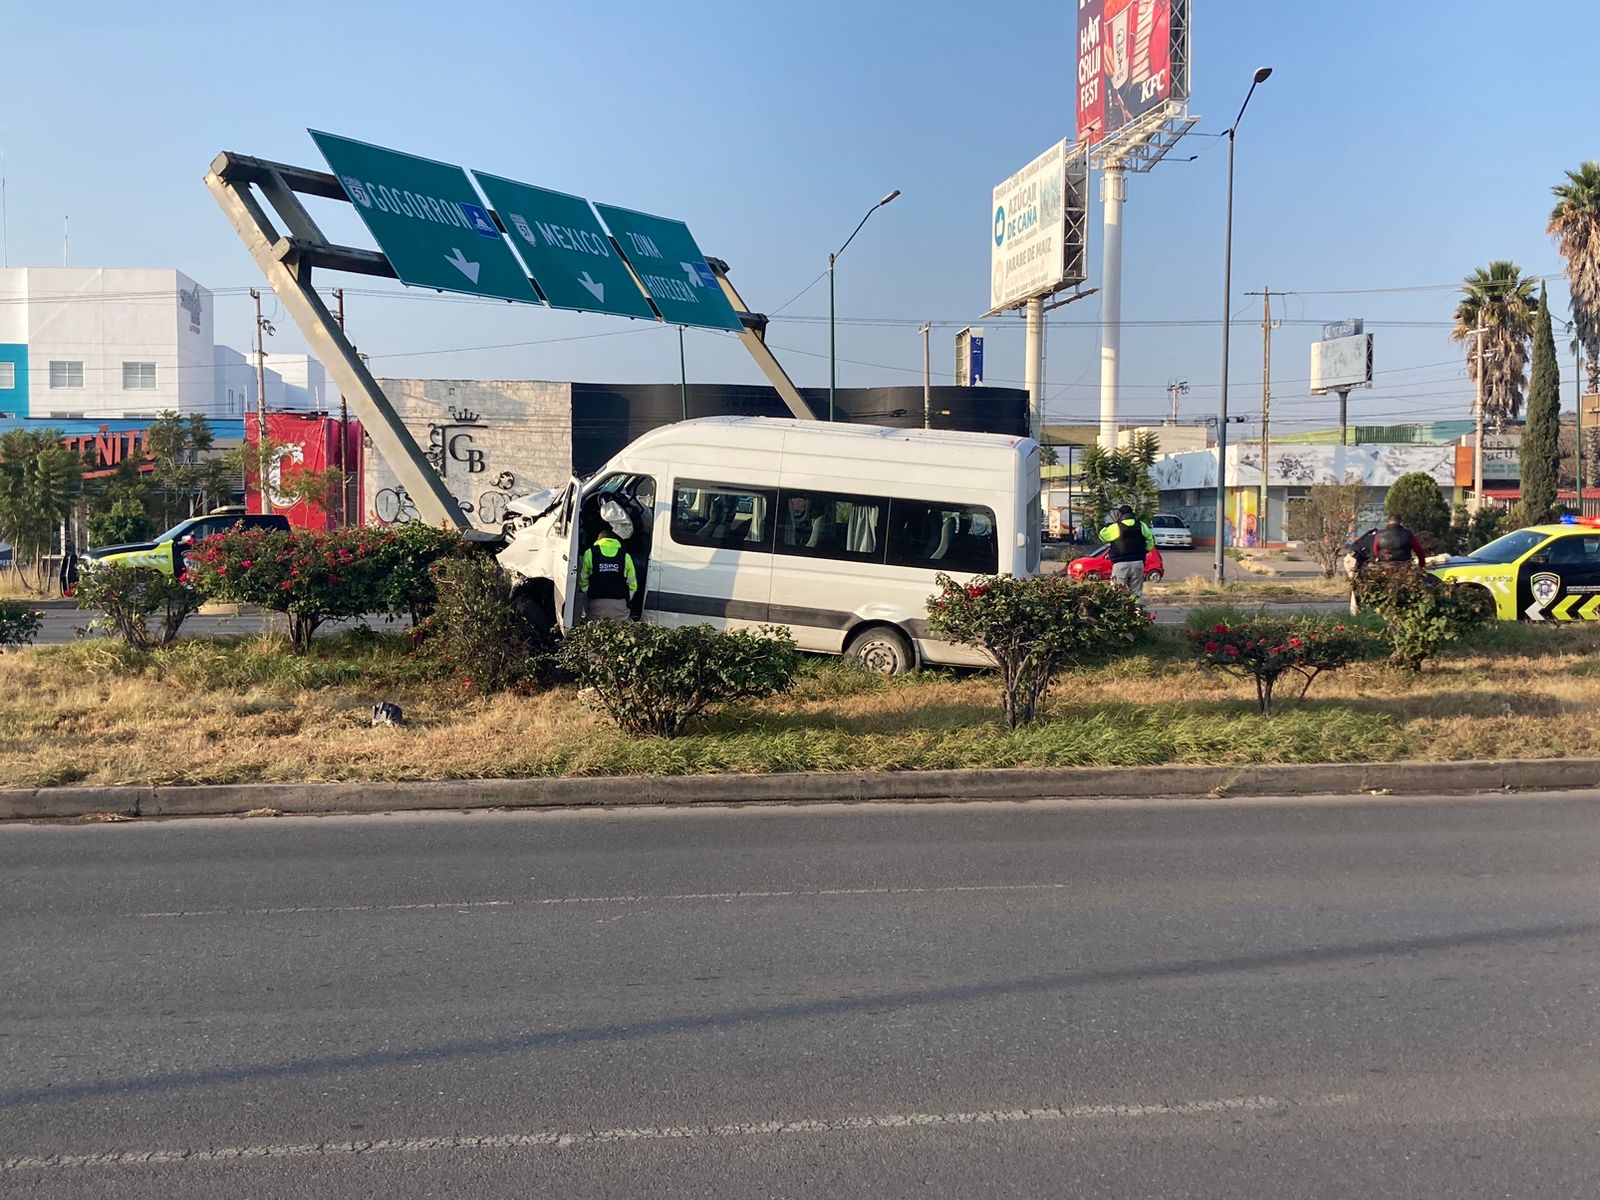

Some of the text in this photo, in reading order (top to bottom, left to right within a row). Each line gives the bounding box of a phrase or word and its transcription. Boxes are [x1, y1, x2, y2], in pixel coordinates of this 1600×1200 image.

[1080, 76, 1099, 112] FEST
[1141, 68, 1166, 103] KFC
[366, 182, 473, 230] GOGORRON
[1008, 182, 1036, 218] AZÚCAR
[535, 221, 609, 258] MEXICO
[1007, 218, 1016, 240] DE
[1017, 204, 1037, 234] CAÑA
[626, 232, 663, 259] ZONA
[1005, 250, 1026, 279] JARABE
[1027, 244, 1035, 263] DE
[641, 274, 699, 303] HOTELERA
